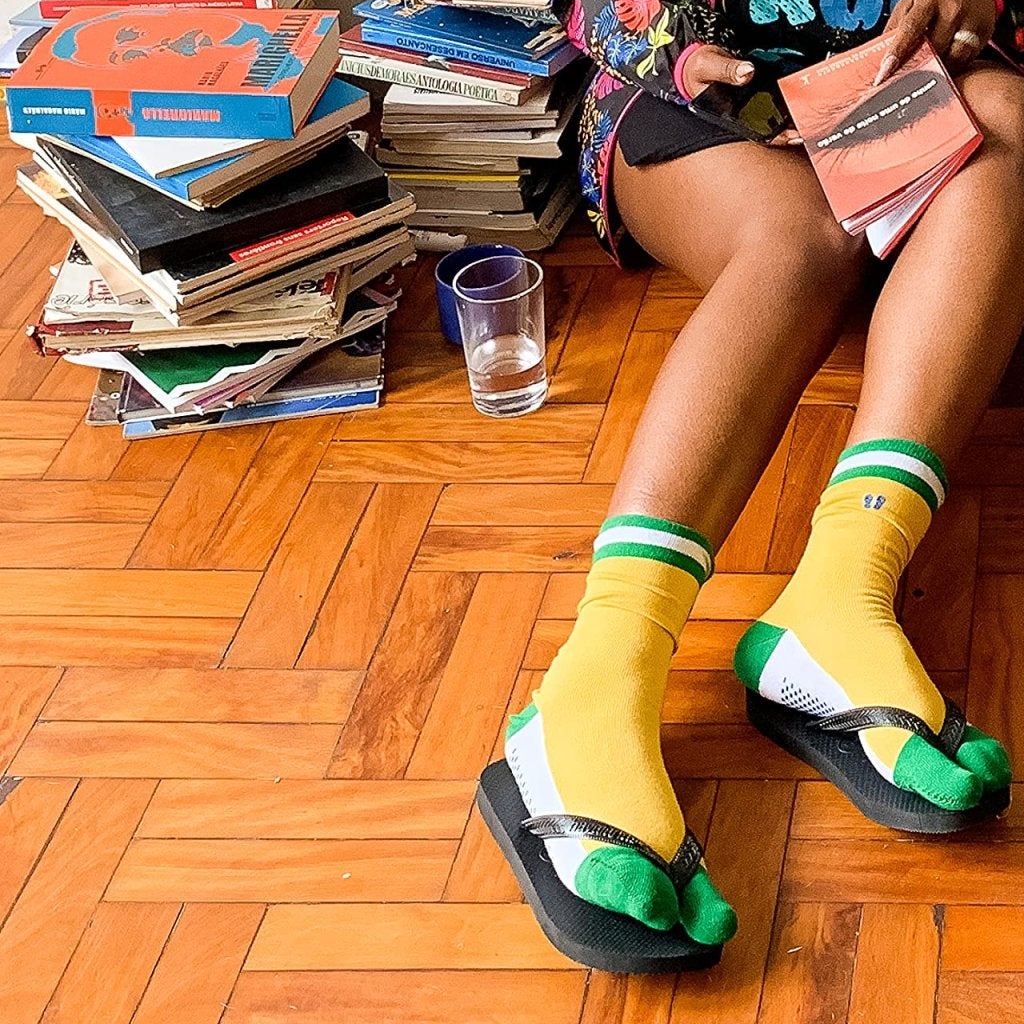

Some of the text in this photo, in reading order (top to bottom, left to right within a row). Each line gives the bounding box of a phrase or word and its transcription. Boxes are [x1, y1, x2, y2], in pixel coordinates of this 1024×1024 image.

[239, 13, 313, 87] MARIGHELLA
[397, 37, 515, 68] UNIVERSO EM DESENCANTO
[415, 73, 463, 95] ANTOLOGIA
[816, 78, 938, 149] sonho de uma noite de verão
[238, 214, 349, 259] Reporters sans frontières
